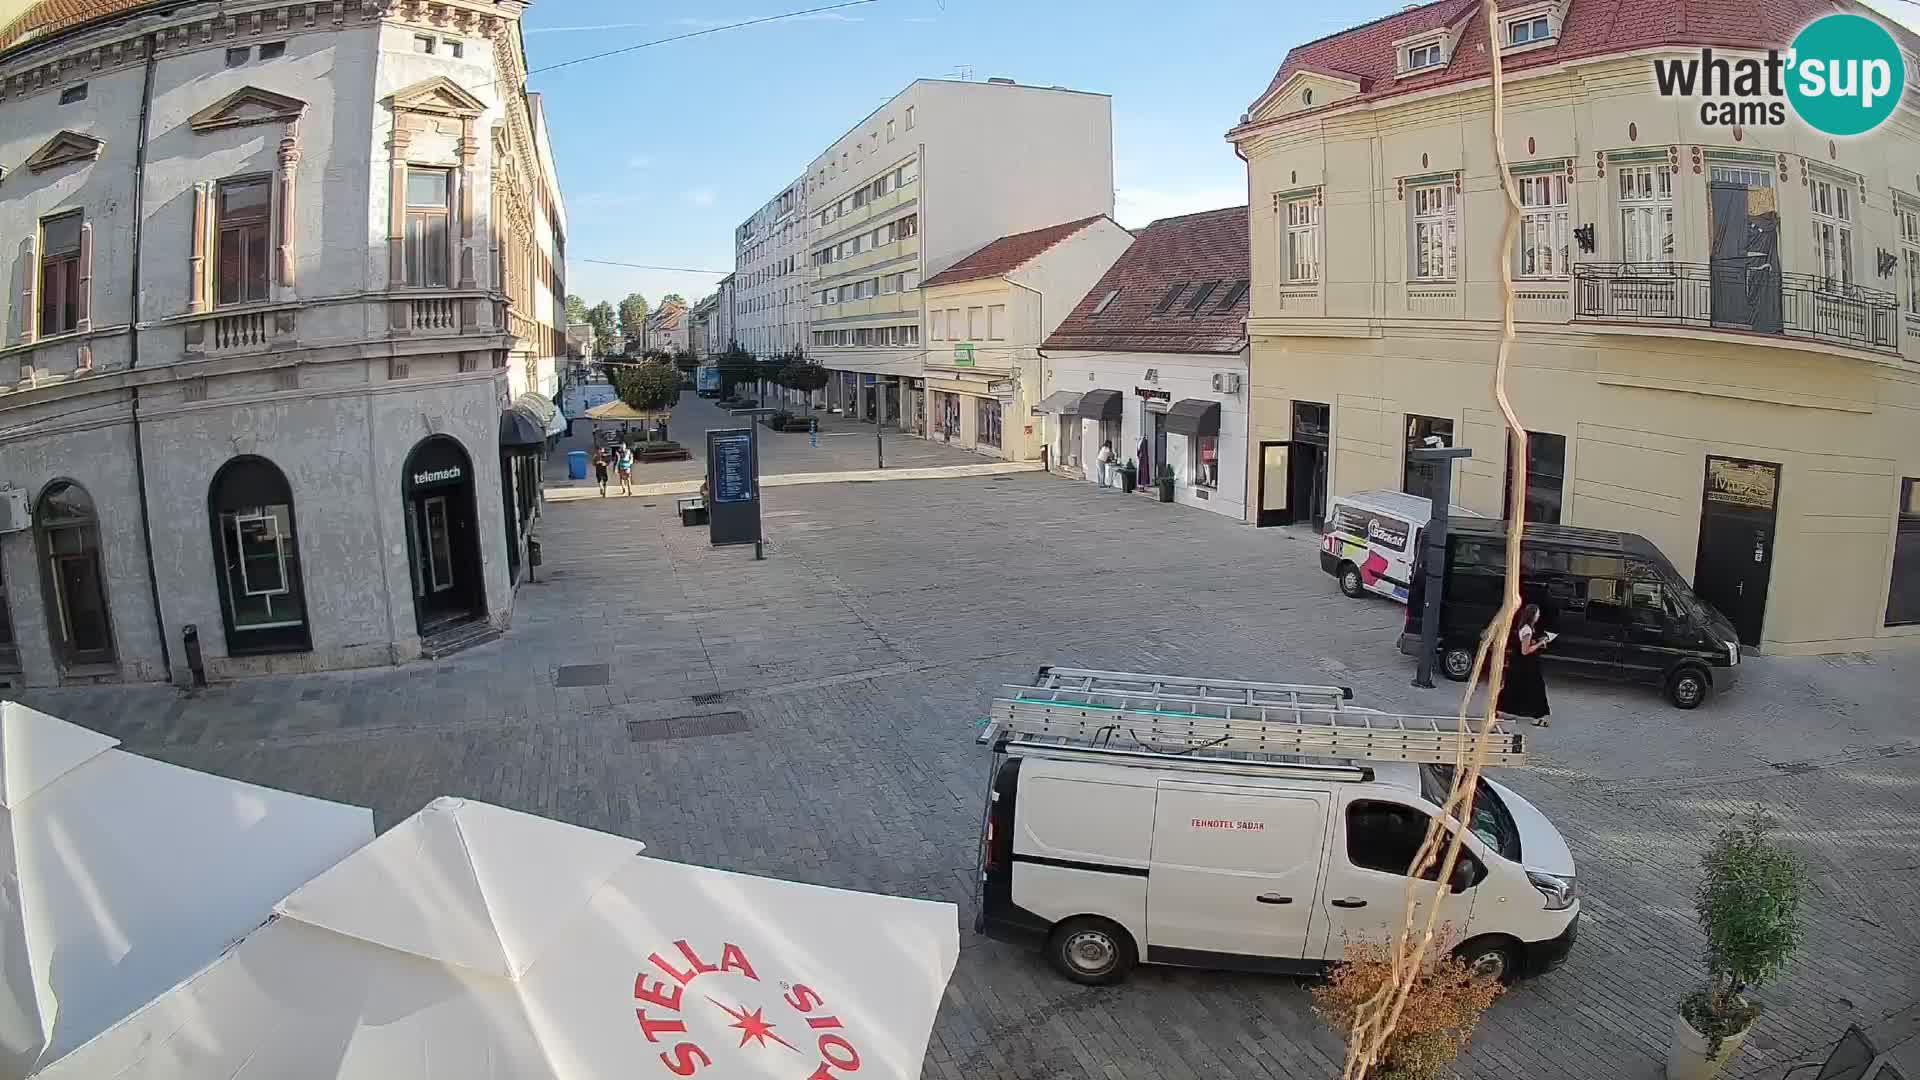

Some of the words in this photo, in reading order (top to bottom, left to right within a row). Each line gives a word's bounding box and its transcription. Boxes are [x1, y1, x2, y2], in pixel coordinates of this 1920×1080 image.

[413, 466, 461, 484] telemach
[1191, 819, 1234, 829] TEHNOTEL
[634, 939, 761, 1076] STELLA
